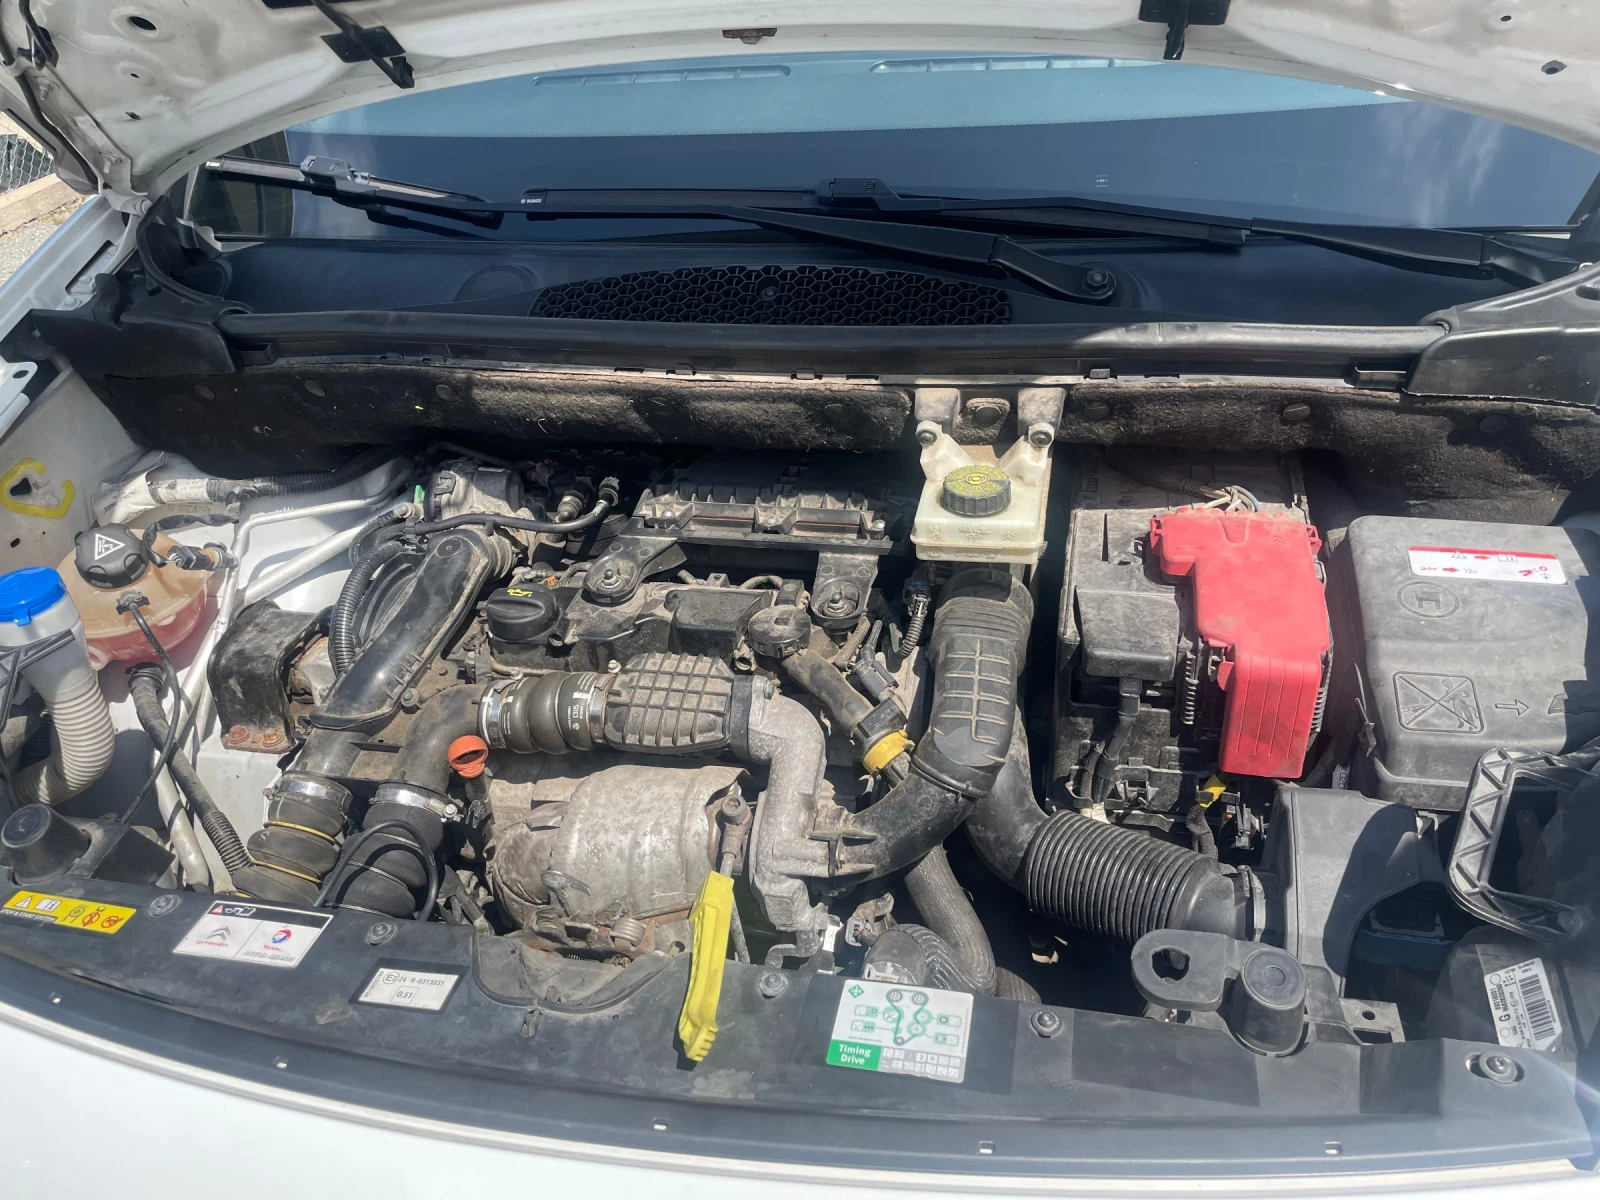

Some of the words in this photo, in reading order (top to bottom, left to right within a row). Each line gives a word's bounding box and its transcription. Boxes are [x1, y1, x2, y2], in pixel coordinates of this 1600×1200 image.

[20, 911, 37, 919] START
[36, 914, 56, 922] SYSTEM
[396, 991, 413, 999] 0.51
[1499, 1013, 1511, 1022] G
[839, 1044, 872, 1057] Timing
[840, 1053, 865, 1065] Drive
